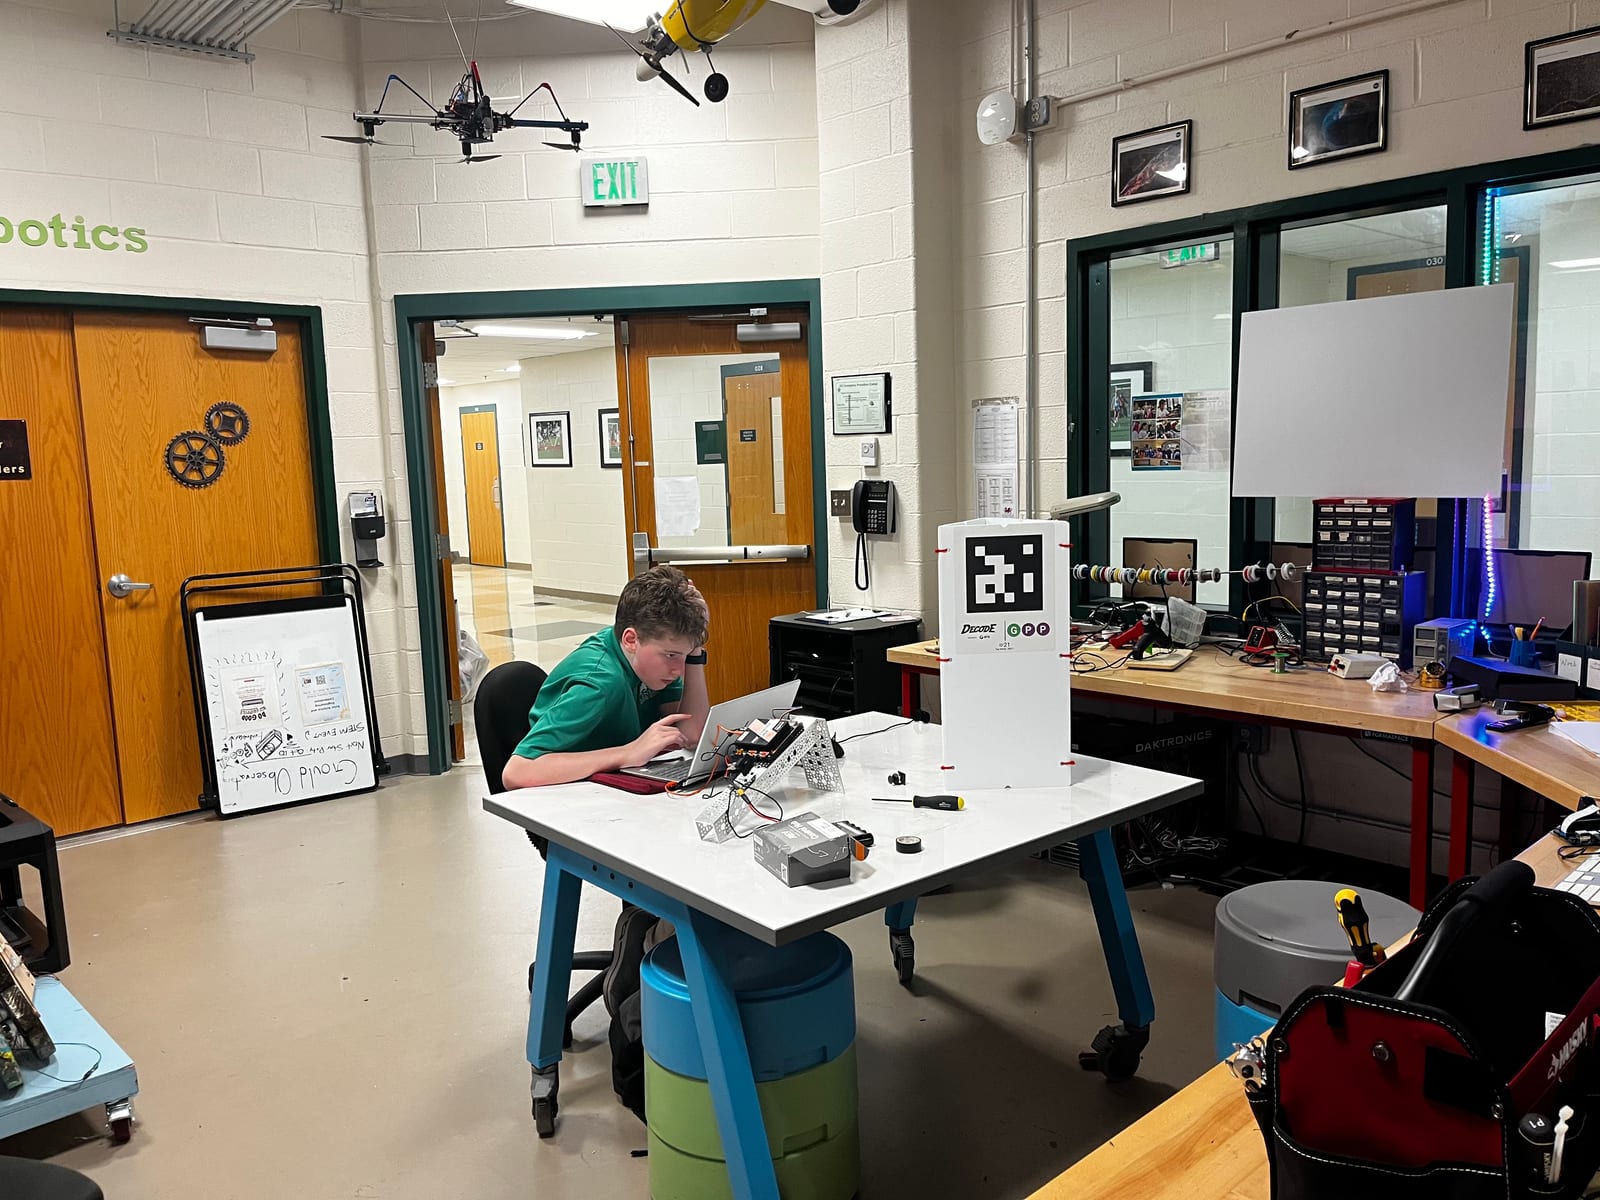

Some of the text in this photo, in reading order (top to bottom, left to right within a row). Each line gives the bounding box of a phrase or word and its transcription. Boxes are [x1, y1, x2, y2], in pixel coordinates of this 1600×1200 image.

[592, 162, 638, 200] EXIT
[1426, 256, 1443, 266] 030
[961, 623, 997, 634] DECODE
[1136, 730, 1213, 753] DAKTRONICS
[299, 759, 358, 789] Gould
